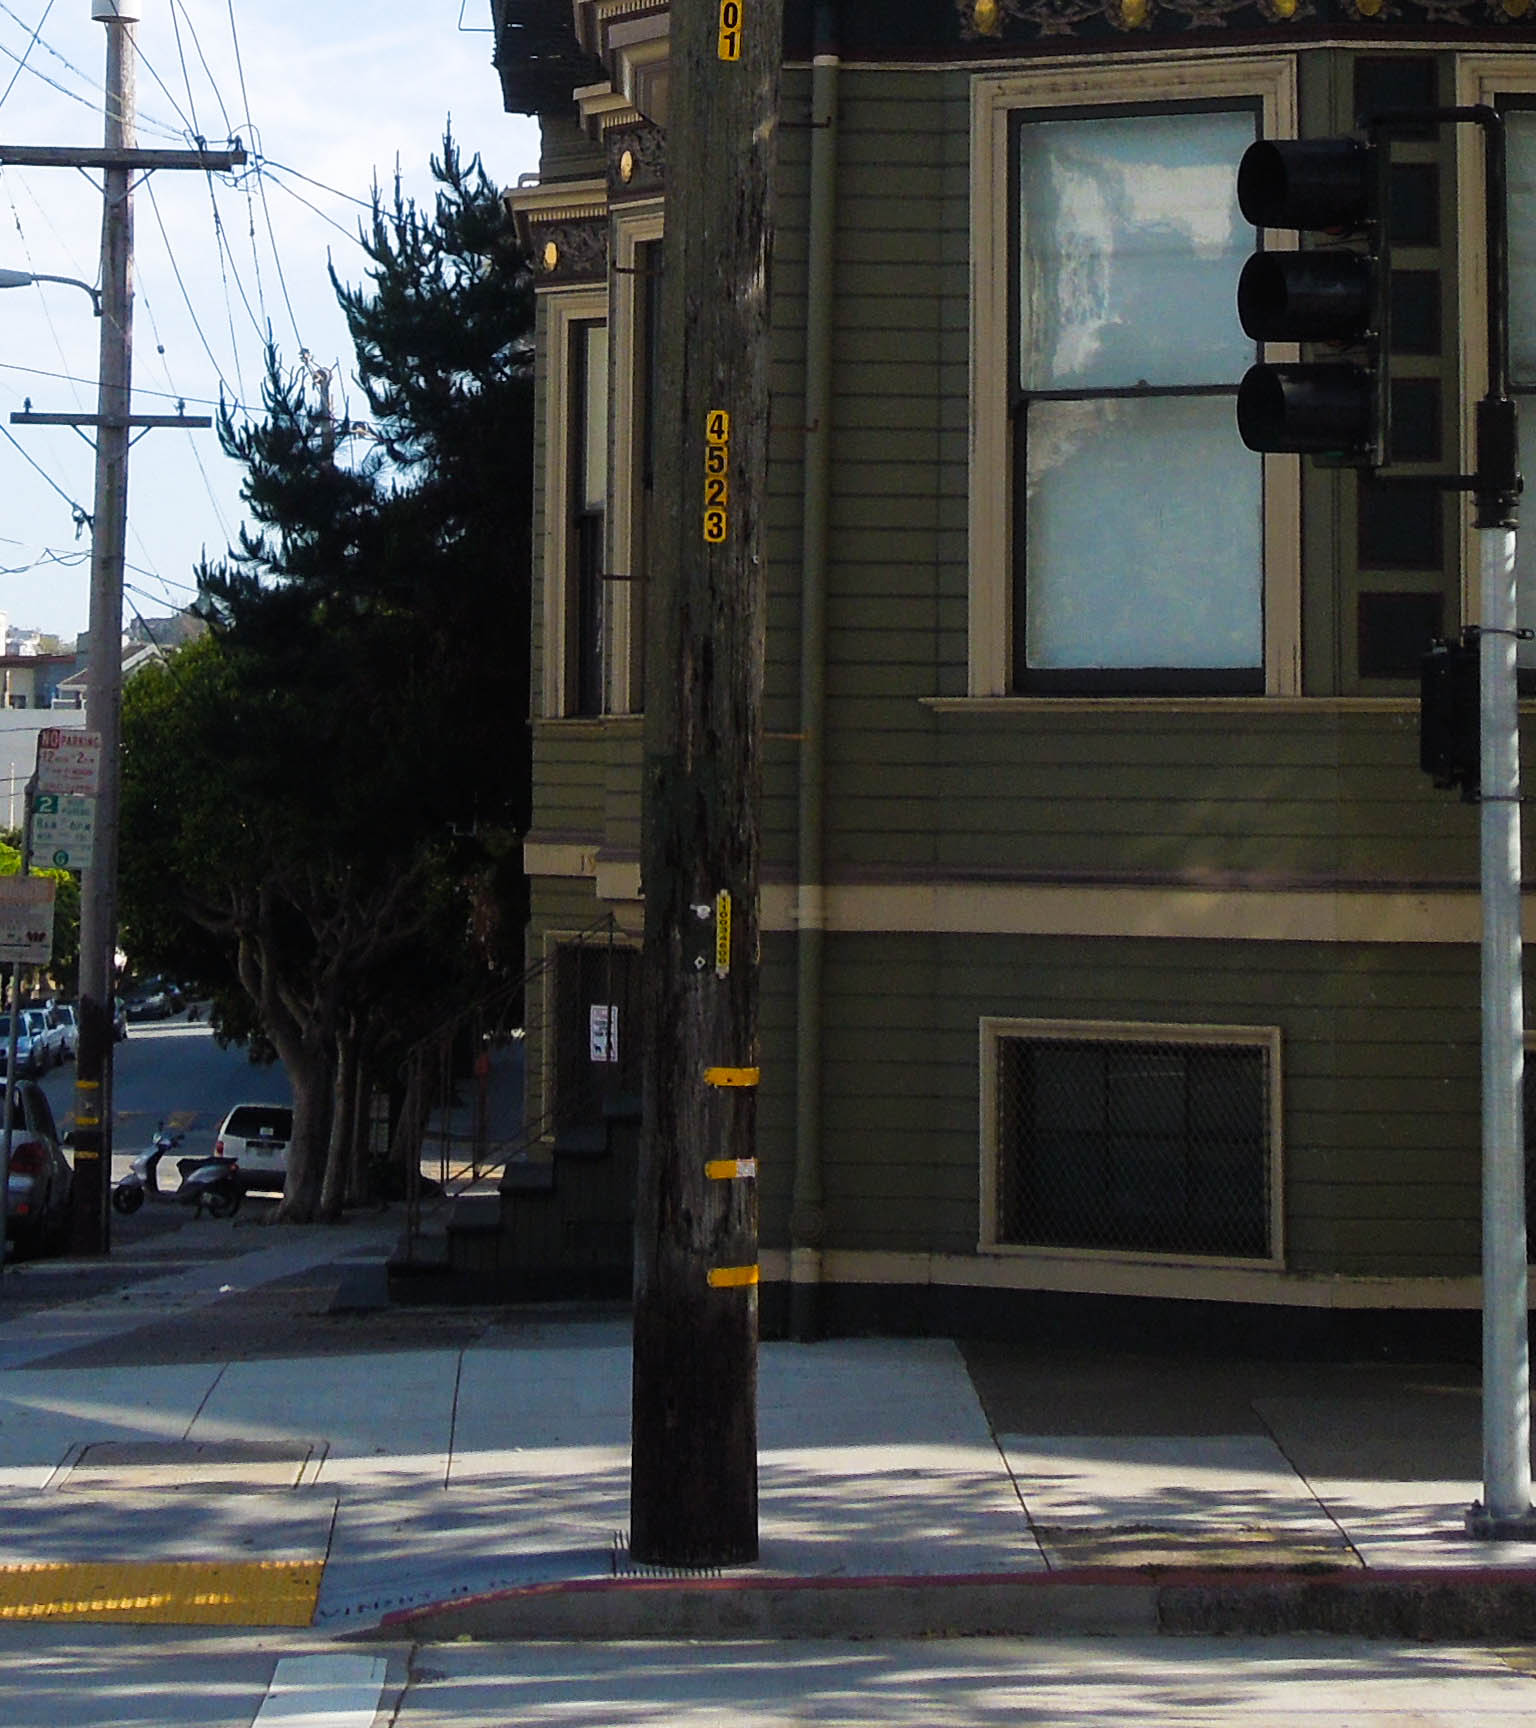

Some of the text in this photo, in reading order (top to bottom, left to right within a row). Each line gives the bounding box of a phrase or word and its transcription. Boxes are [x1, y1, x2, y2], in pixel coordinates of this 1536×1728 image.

[707, 414, 725, 539] 4523
[41, 730, 58, 747] NO
[39, 796, 53, 812] 2
